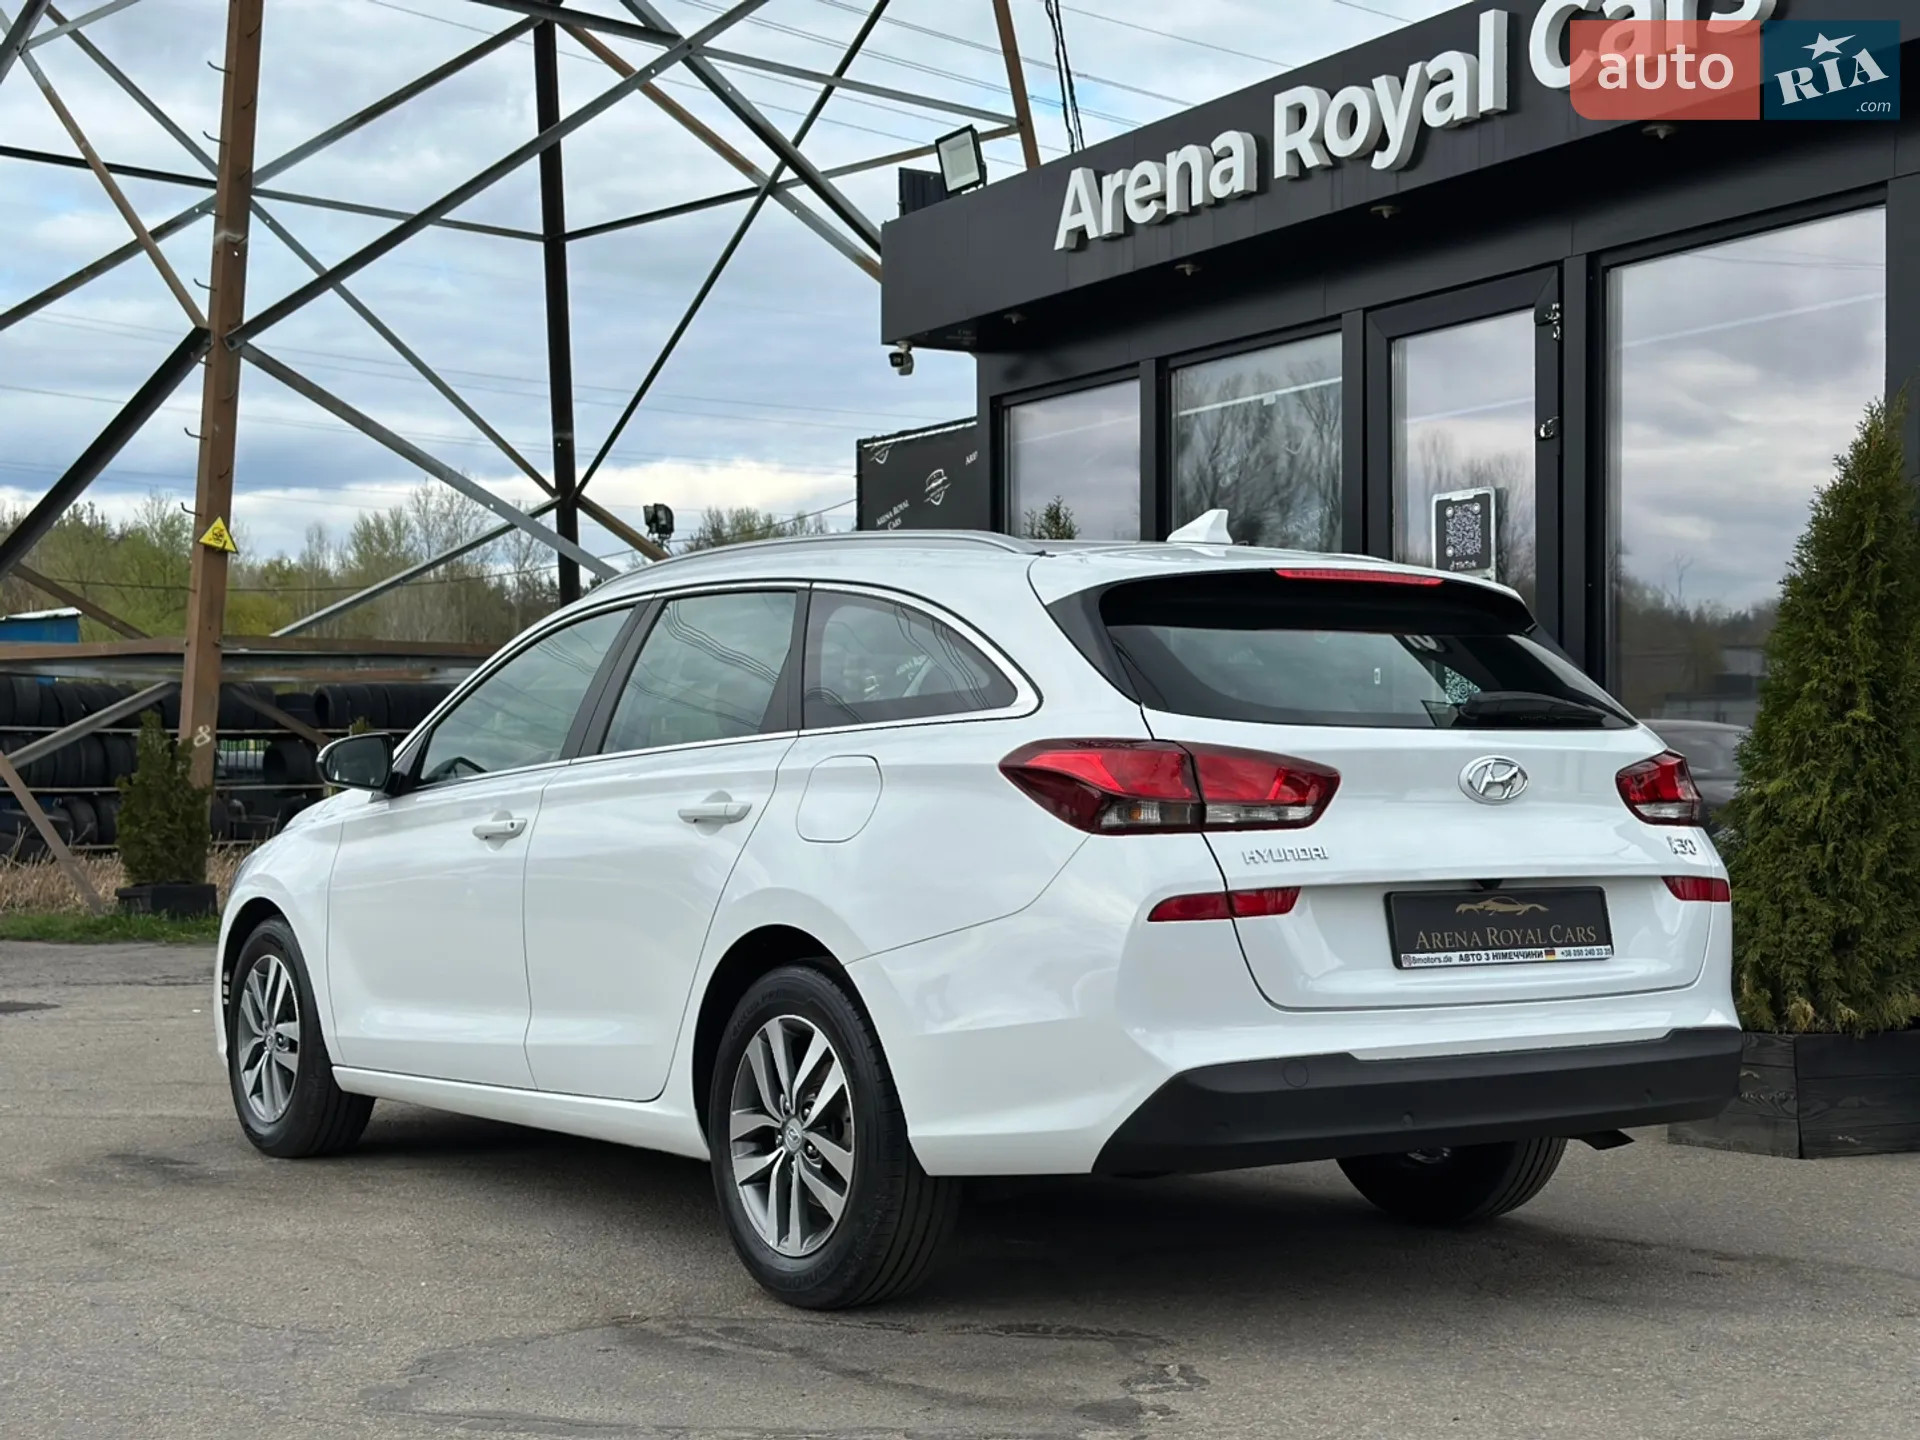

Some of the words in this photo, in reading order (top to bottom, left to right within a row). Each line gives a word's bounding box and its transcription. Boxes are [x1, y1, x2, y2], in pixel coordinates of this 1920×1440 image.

[1054, 130, 1258, 252] Arena
[1274, 9, 1507, 179] Royal
[1241, 846, 1329, 866] HYUNDAI
[1415, 930, 1482, 950] ARENA
[1485, 926, 1548, 948] ROYAL
[1550, 924, 1597, 944] CARS
[1458, 953, 1483, 963] АВТО
[1492, 950, 1544, 961] НІМЕЧЧИНИ
